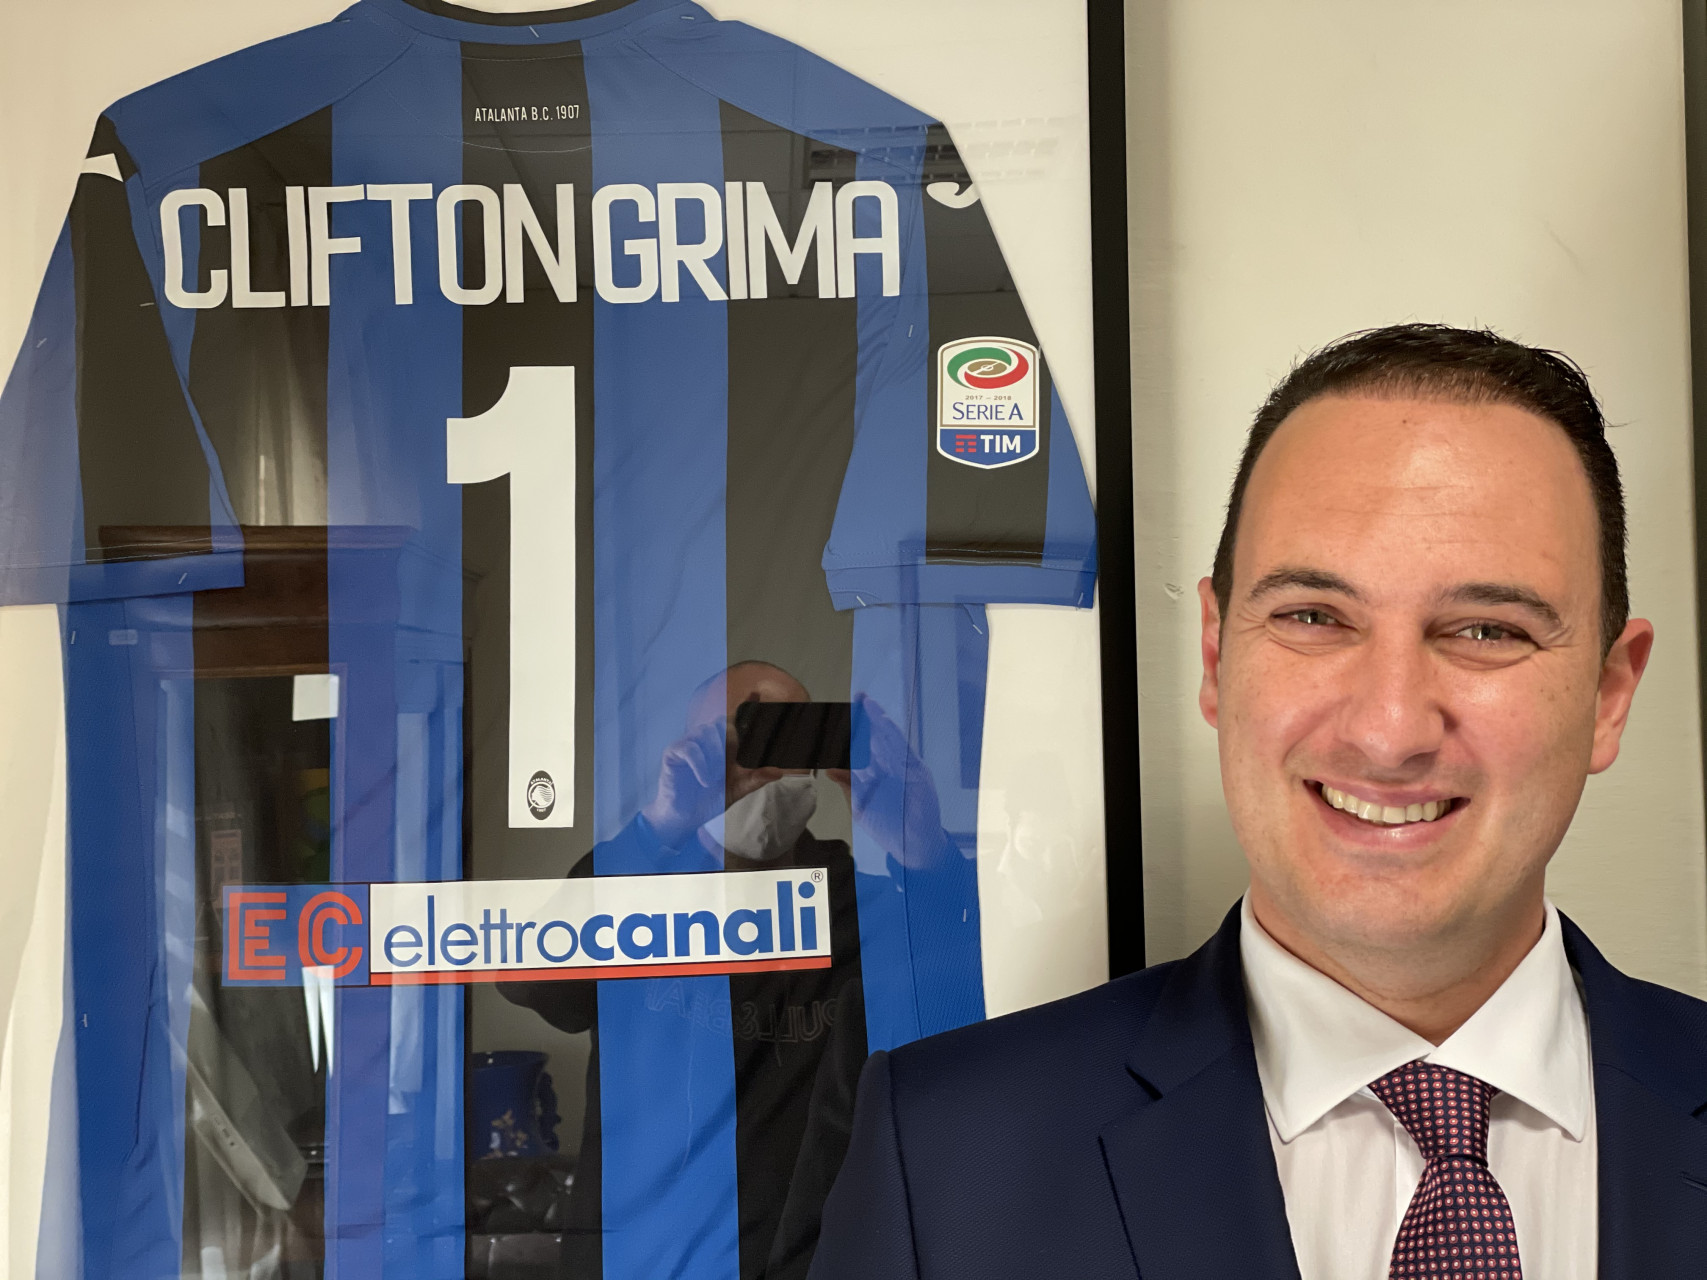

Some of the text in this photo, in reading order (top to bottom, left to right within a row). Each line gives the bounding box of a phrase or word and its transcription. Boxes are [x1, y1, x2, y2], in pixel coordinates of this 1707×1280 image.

[474, 104, 580, 122] ATALANTA B.C. 1907
[160, 180, 900, 309] CLIFTON GRIMA
[952, 401, 1024, 421] SERIE A
[980, 434, 1021, 453] TIM
[446, 366, 576, 829] 1
[228, 891, 363, 981] EC
[384, 880, 818, 967] elettrocanali
